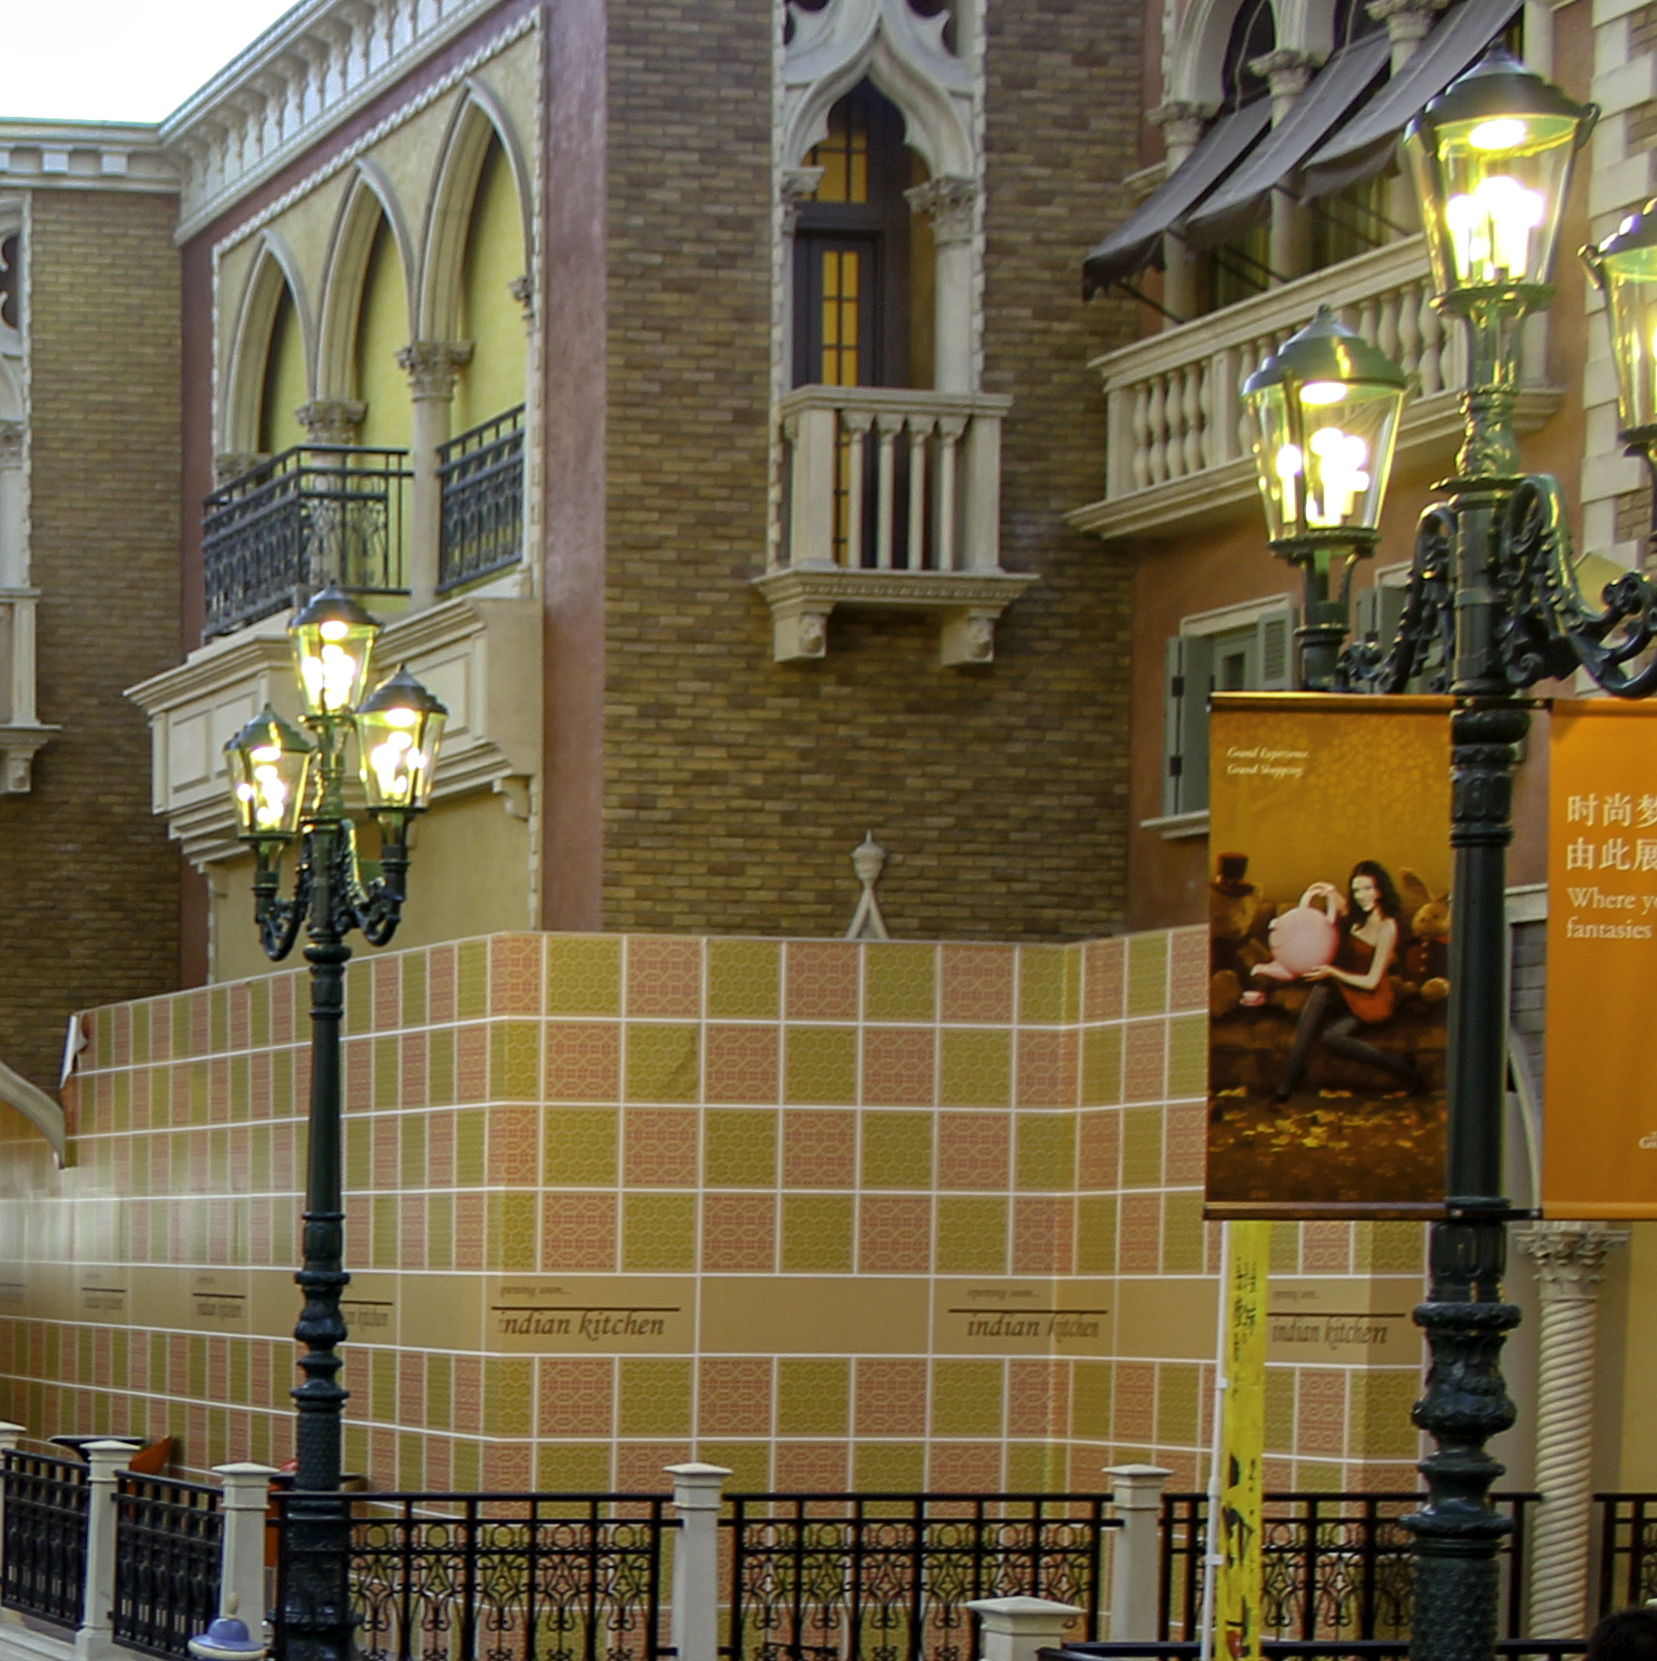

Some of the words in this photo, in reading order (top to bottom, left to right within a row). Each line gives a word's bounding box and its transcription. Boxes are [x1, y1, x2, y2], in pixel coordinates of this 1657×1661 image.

[1227, 747, 1259, 759] Grand
[1227, 763, 1259, 775] Grand
[1566, 887, 1636, 909] Where
[1641, 895, 1657, 916] y
[1566, 916, 1653, 939] fantasies
[499, 1310, 570, 1335] indian
[578, 1310, 665, 1341] kitchen
[967, 1312, 1040, 1336] indian
[1047, 1312, 1099, 1343] kitchen
[1272, 1317, 1320, 1342] indian
[1325, 1317, 1388, 1350] kitchen
